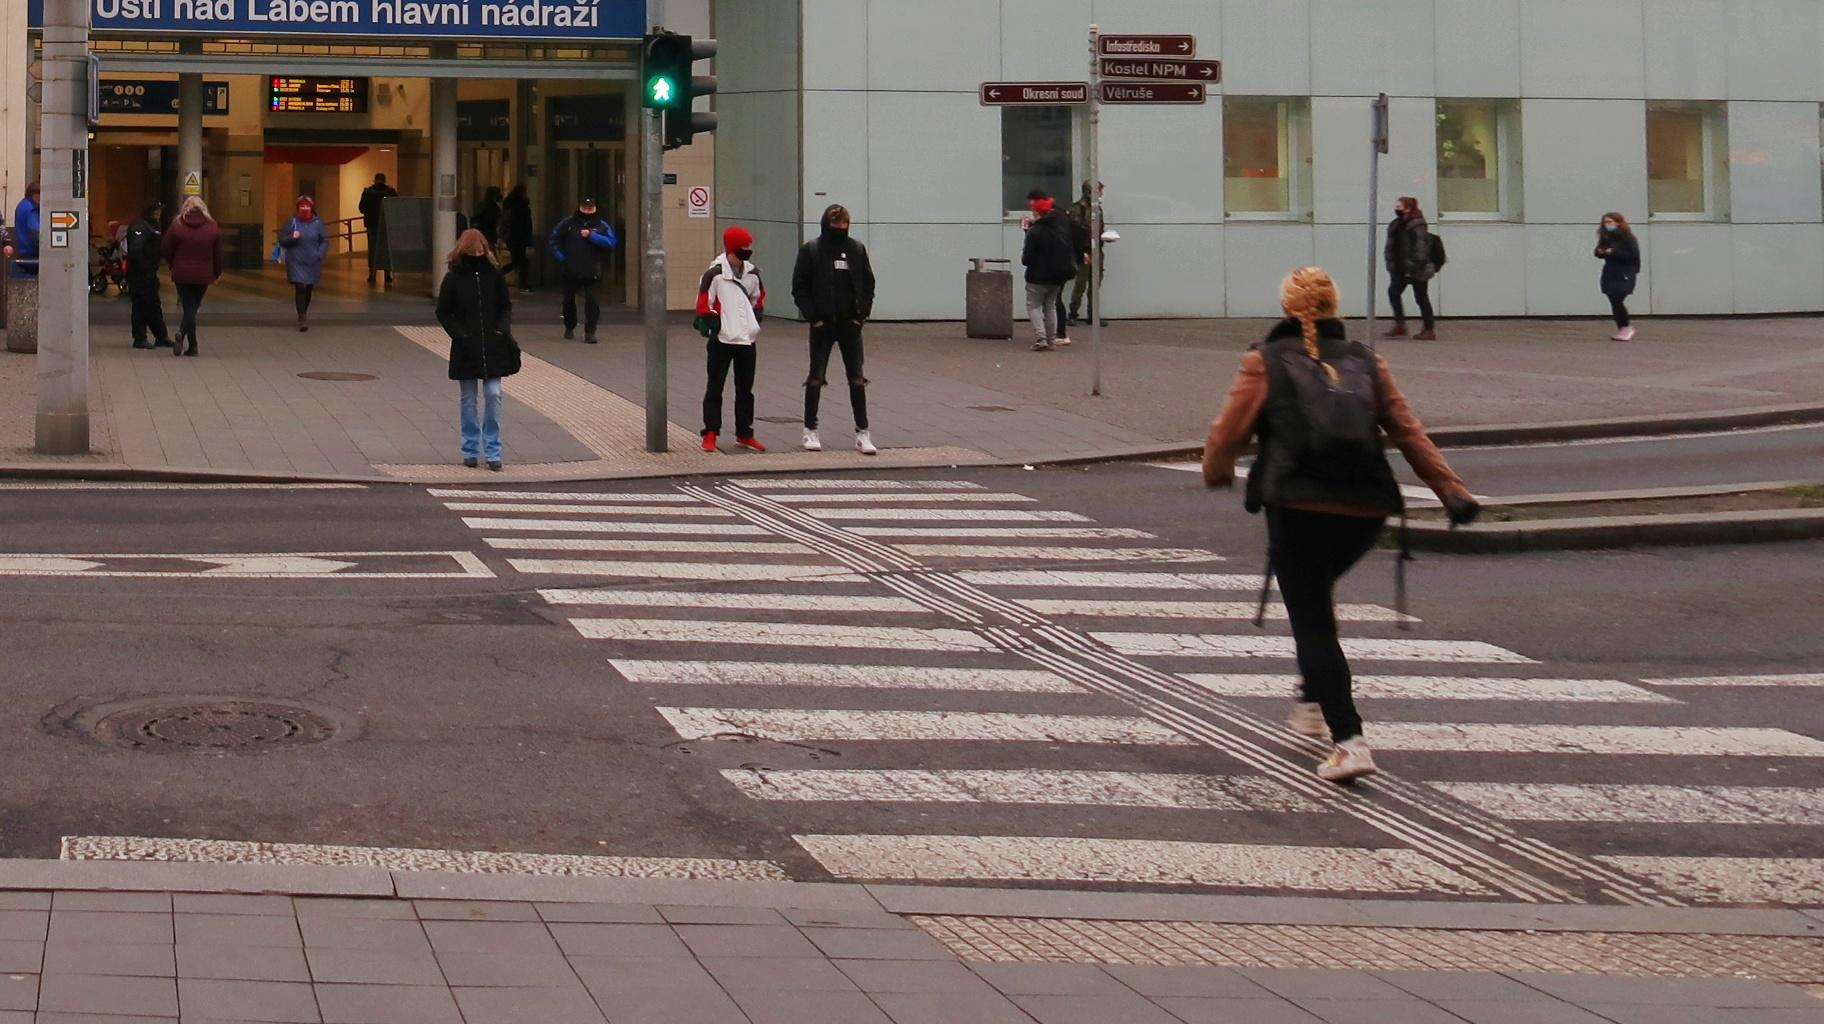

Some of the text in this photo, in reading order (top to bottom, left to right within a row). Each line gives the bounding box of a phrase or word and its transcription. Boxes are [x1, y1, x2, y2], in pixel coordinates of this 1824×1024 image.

[1104, 61, 1186, 77] Kostel NPM
[1022, 87, 1084, 100] Okresní soud
[1106, 86, 1154, 99] Větruše
